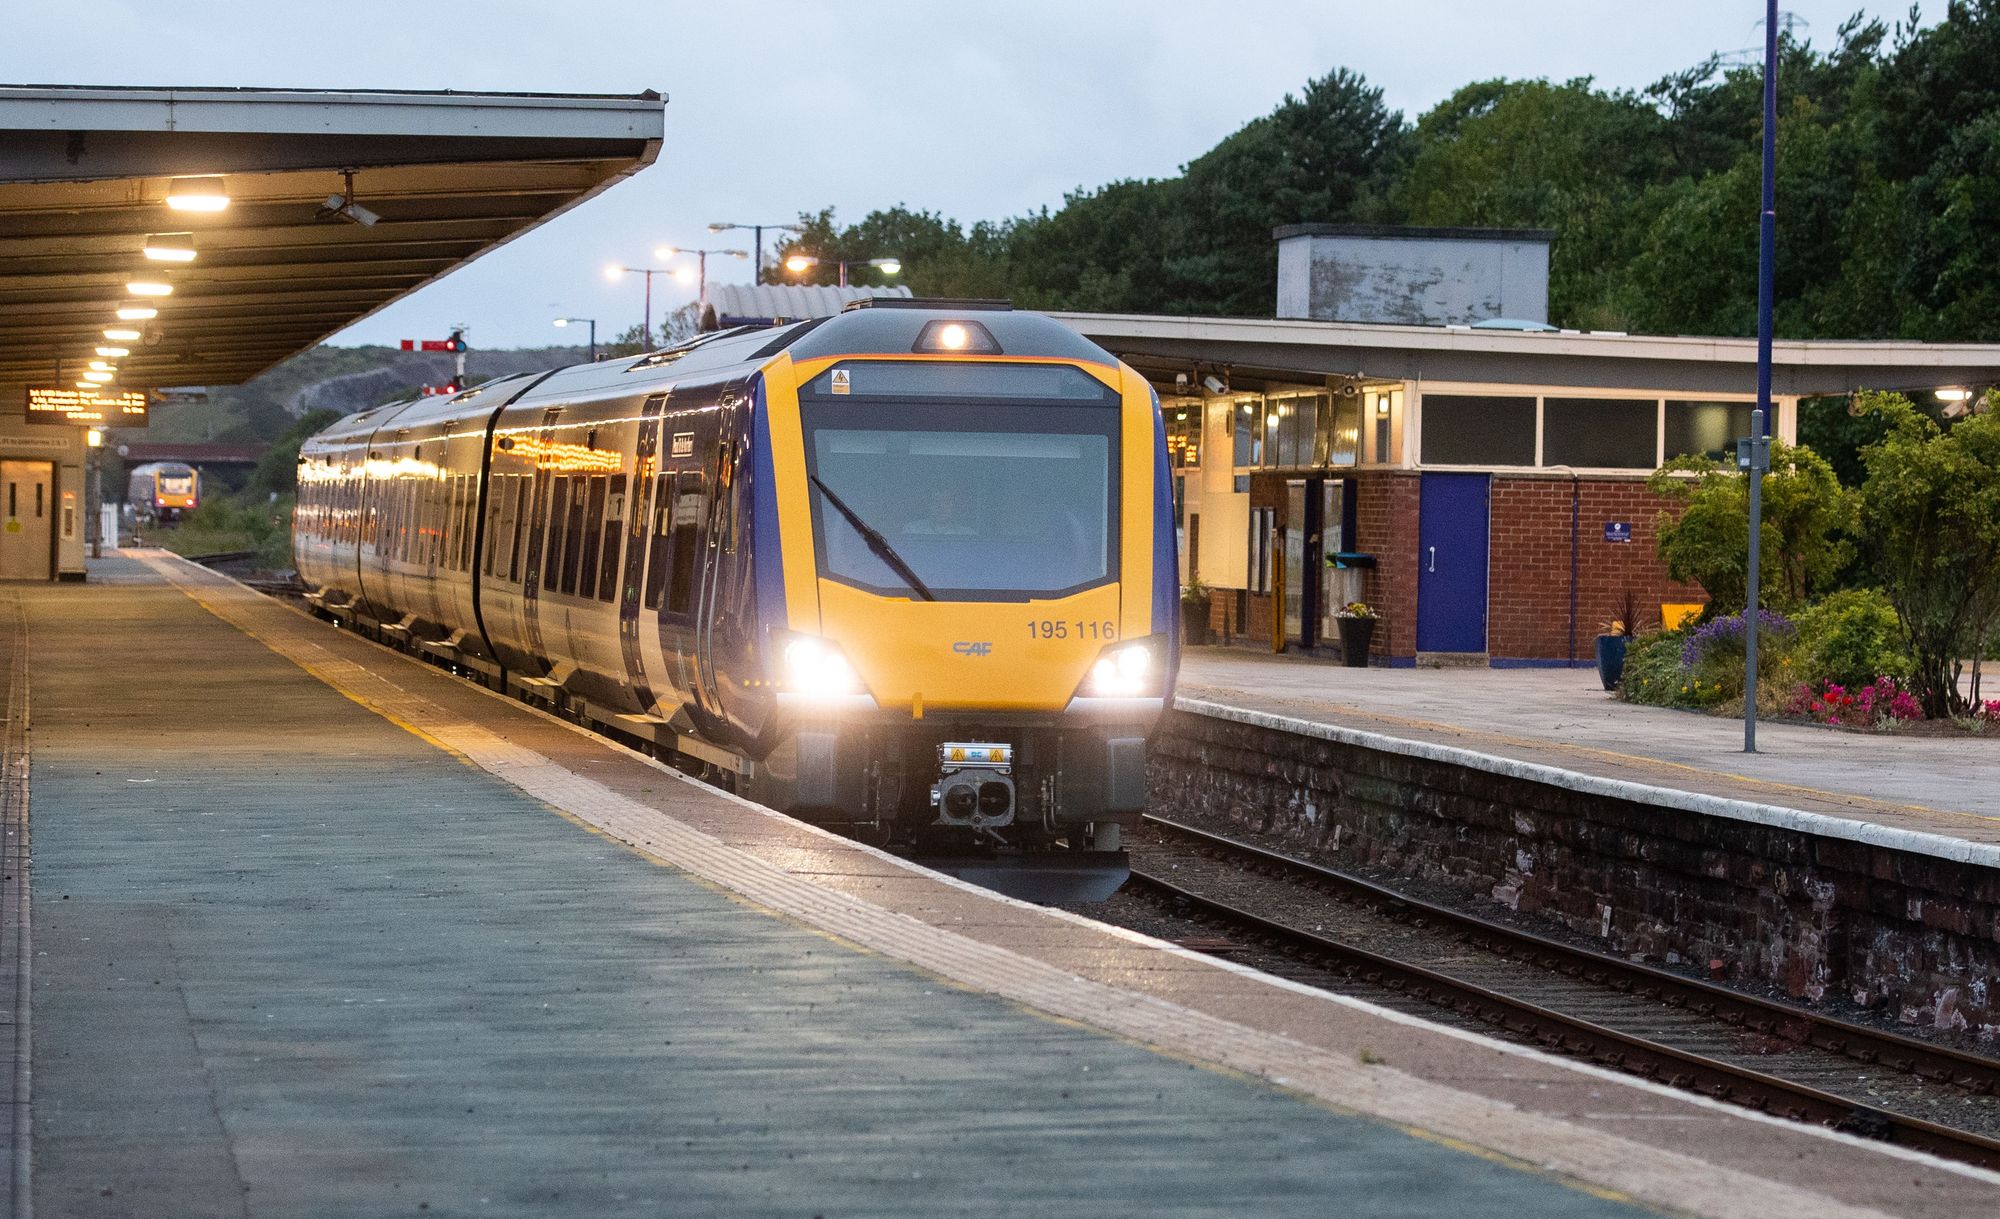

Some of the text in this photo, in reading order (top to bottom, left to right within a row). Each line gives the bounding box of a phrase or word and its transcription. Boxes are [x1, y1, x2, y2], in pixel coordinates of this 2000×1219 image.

[1028, 620, 1115, 640] 195 116
[953, 641, 993, 656] CAF
